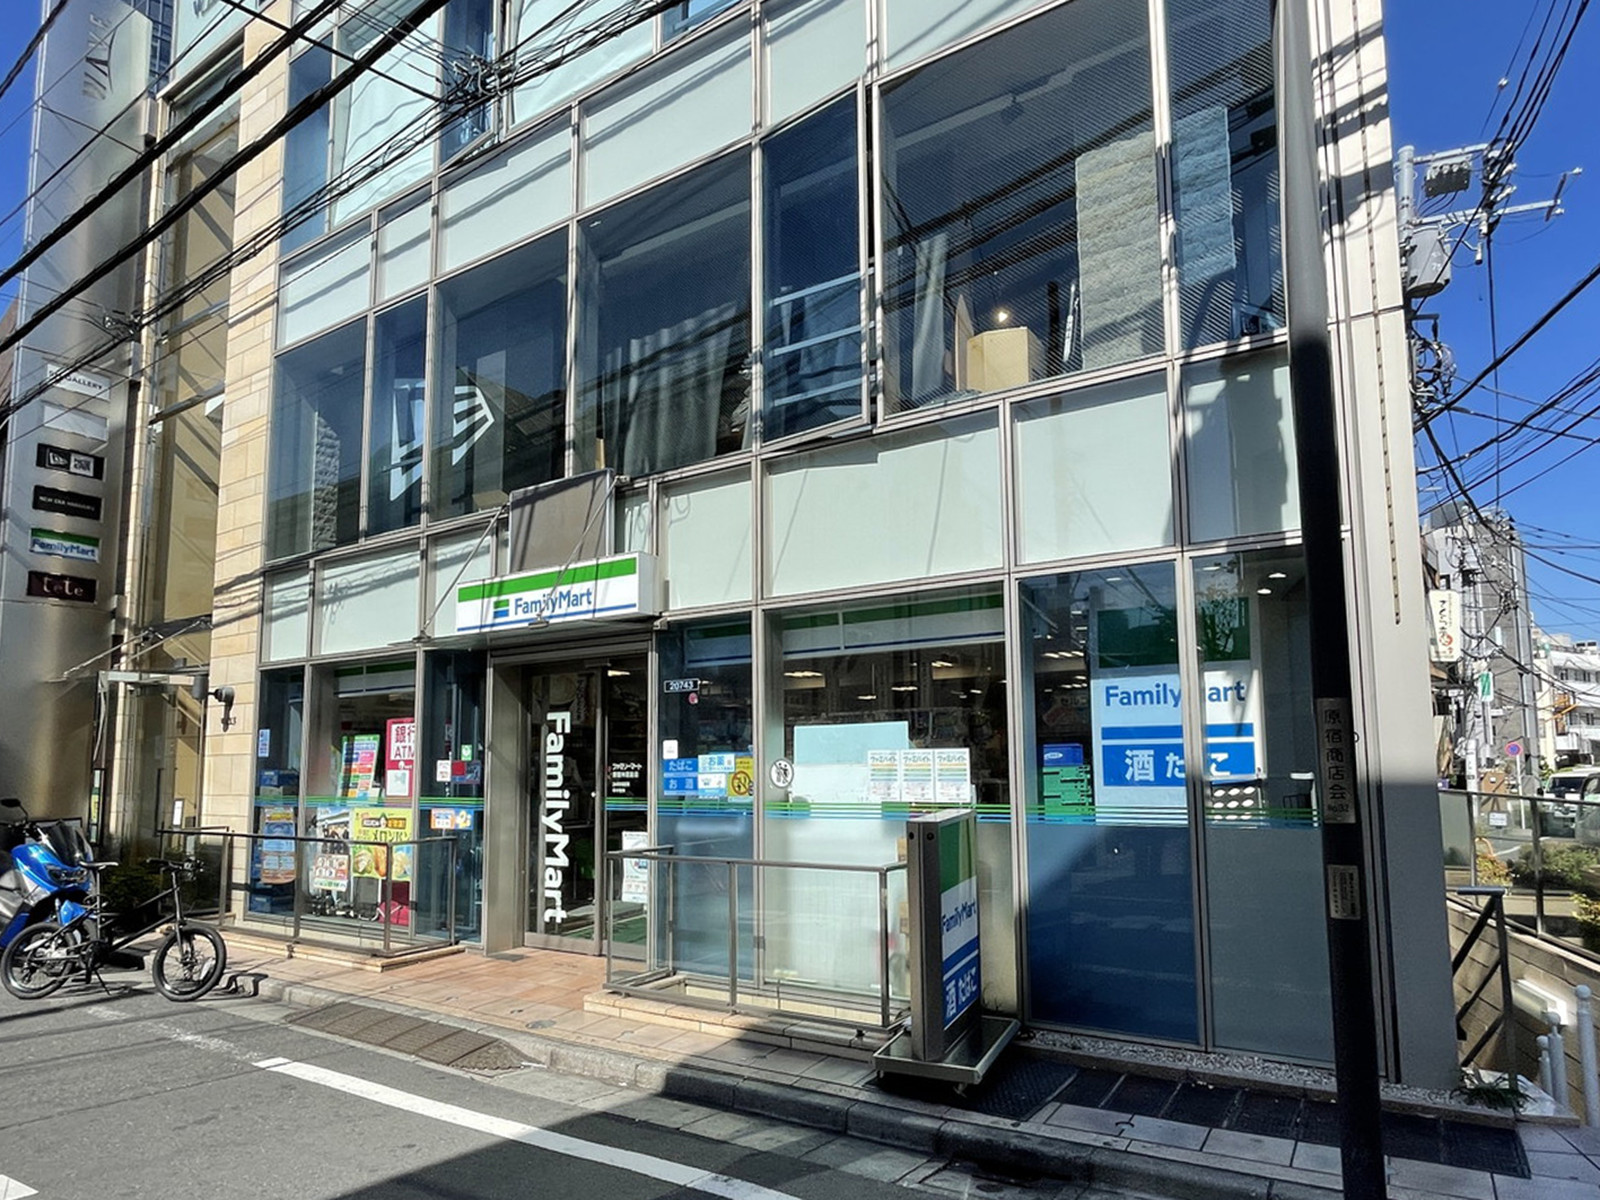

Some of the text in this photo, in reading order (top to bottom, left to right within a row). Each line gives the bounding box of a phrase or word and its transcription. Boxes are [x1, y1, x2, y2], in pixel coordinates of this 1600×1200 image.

[32, 538, 96, 557] FamilyMart
[514, 588, 592, 616] FamilyMart
[669, 679, 694, 692] 20743
[1105, 680, 1246, 708] Familyart
[668, 759, 694, 772] たばこ
[1124, 749, 1155, 782] 酒
[1324, 708, 1347, 800] 原宿商店会
[541, 711, 571, 924] FamilyMart
[942, 900, 976, 935] FamilyMart
[945, 966, 977, 1019] 酒 たばこ
